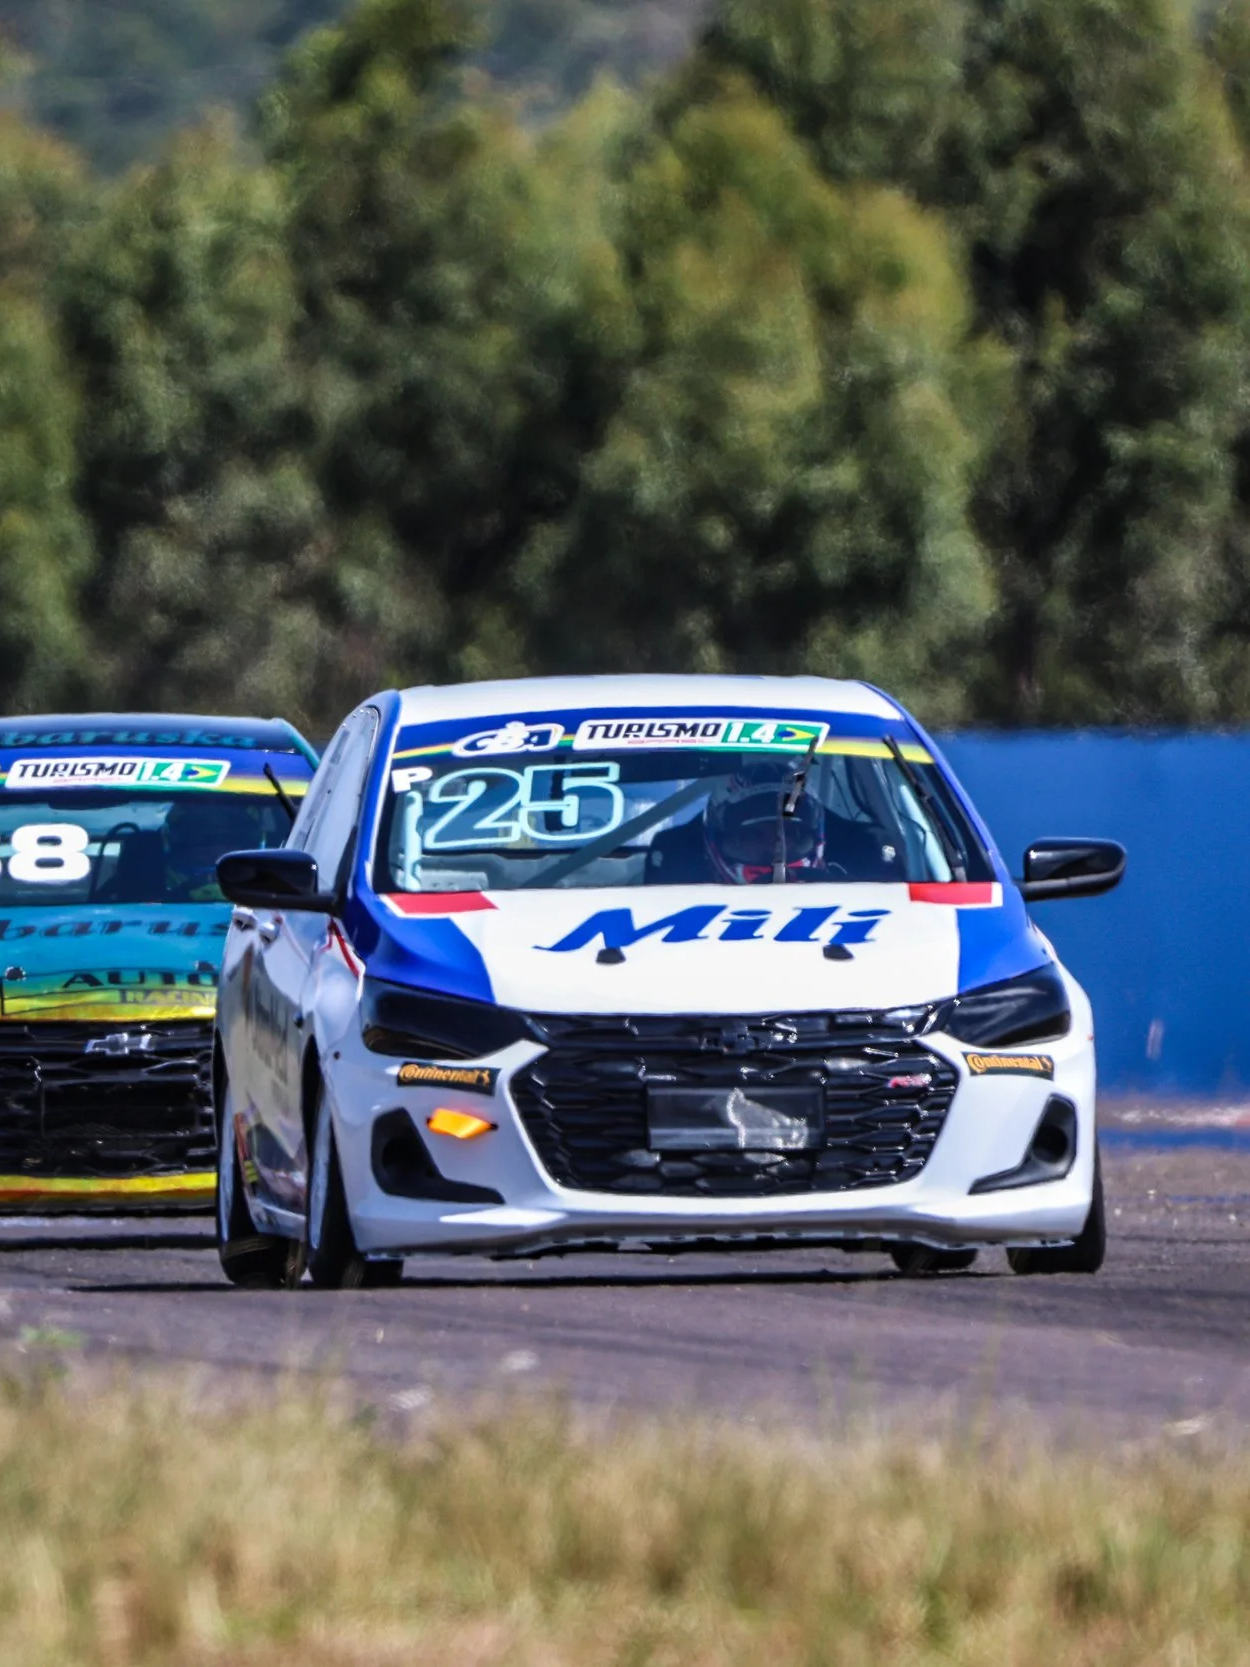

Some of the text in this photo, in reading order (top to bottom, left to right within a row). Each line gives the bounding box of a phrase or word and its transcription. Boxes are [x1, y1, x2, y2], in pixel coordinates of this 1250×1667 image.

[586, 721, 776, 744] TURISMO 1.4
[17, 761, 182, 782] TURISMO 1.4
[424, 762, 624, 849] 25
[533, 904, 892, 952] Mili
[399, 1064, 480, 1085] Continental
